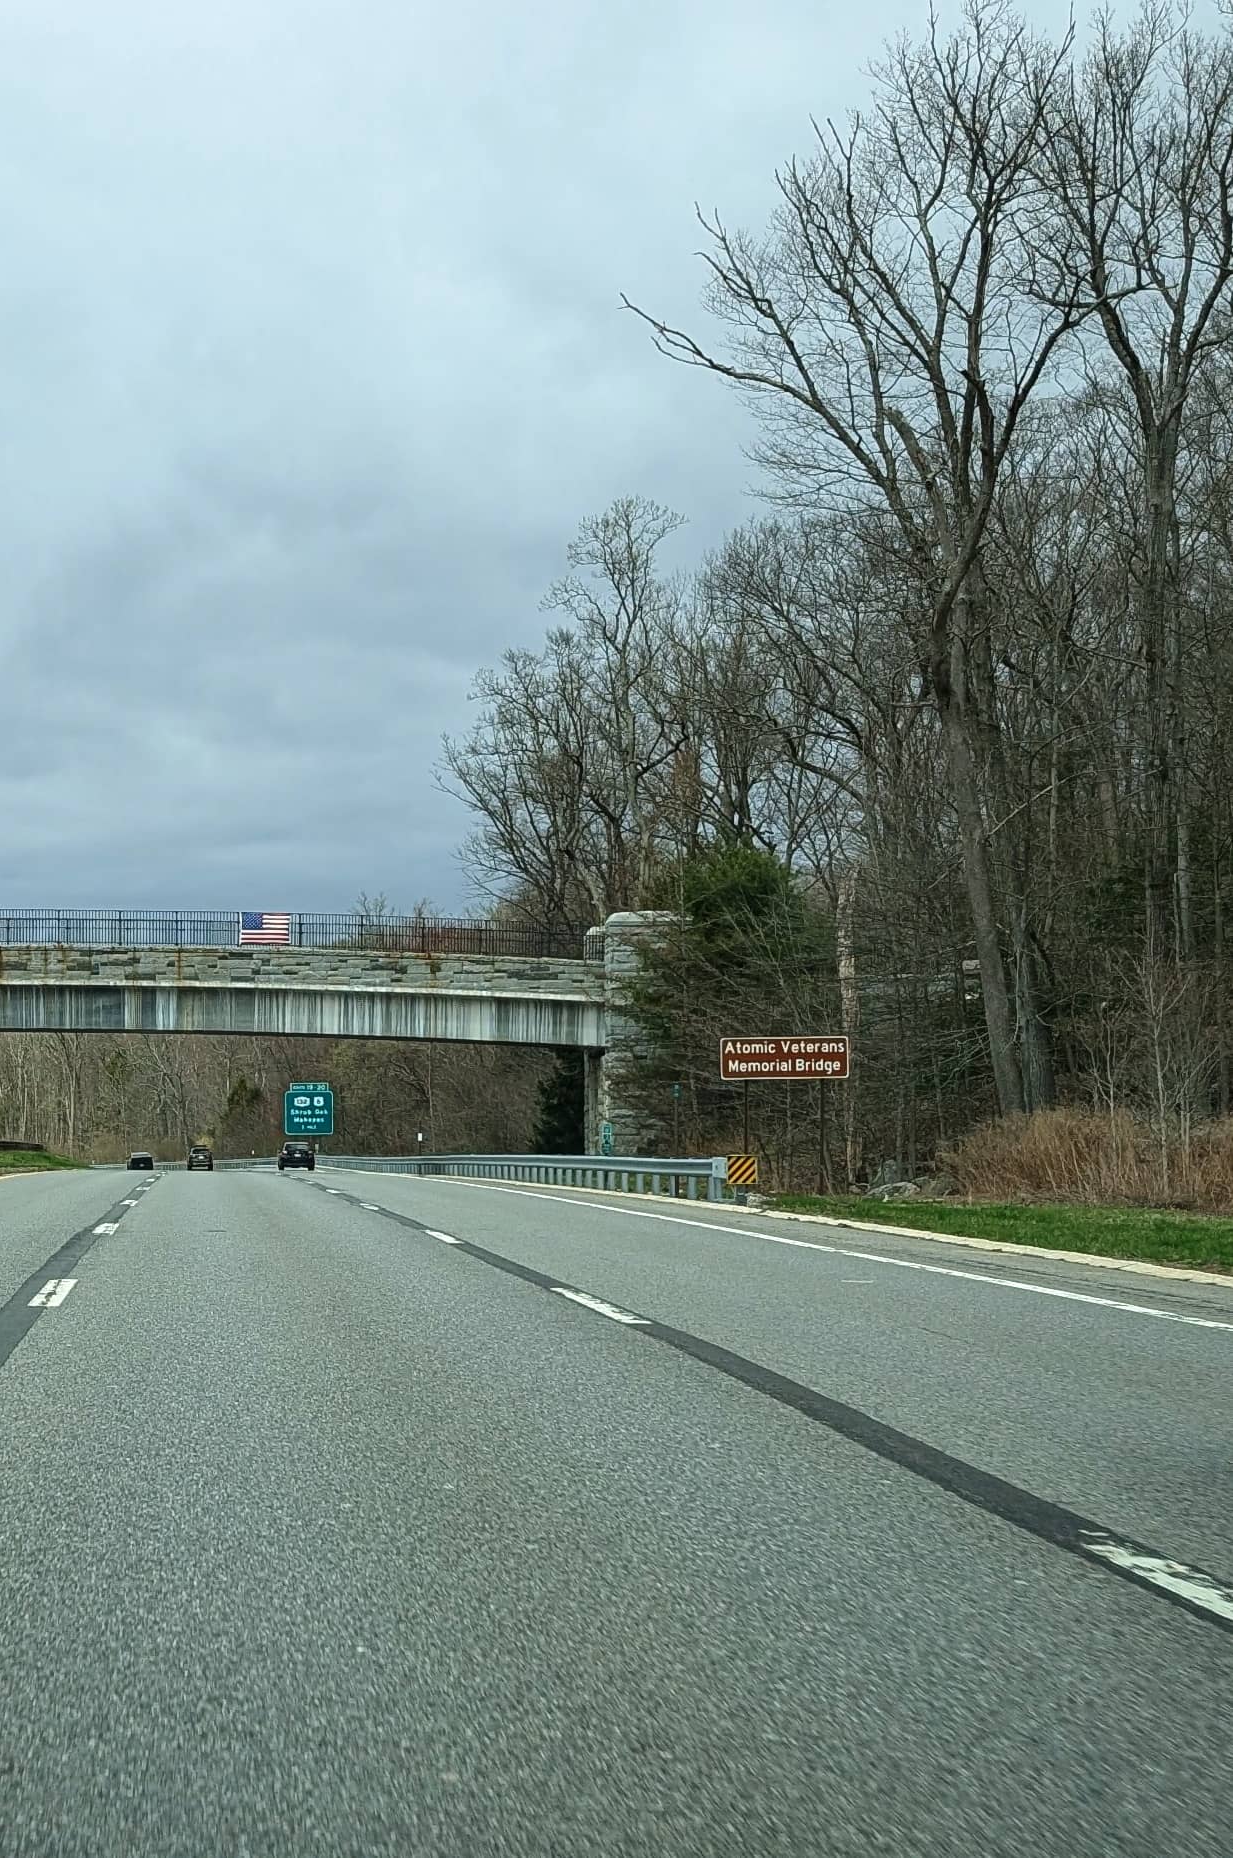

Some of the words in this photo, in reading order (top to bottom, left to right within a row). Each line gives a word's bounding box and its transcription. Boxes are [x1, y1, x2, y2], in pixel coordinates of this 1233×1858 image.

[725, 1041, 776, 1054] Atomic
[781, 1041, 845, 1054] Veterans
[728, 1059, 792, 1073] Memorial
[795, 1058, 841, 1074] Bridge
